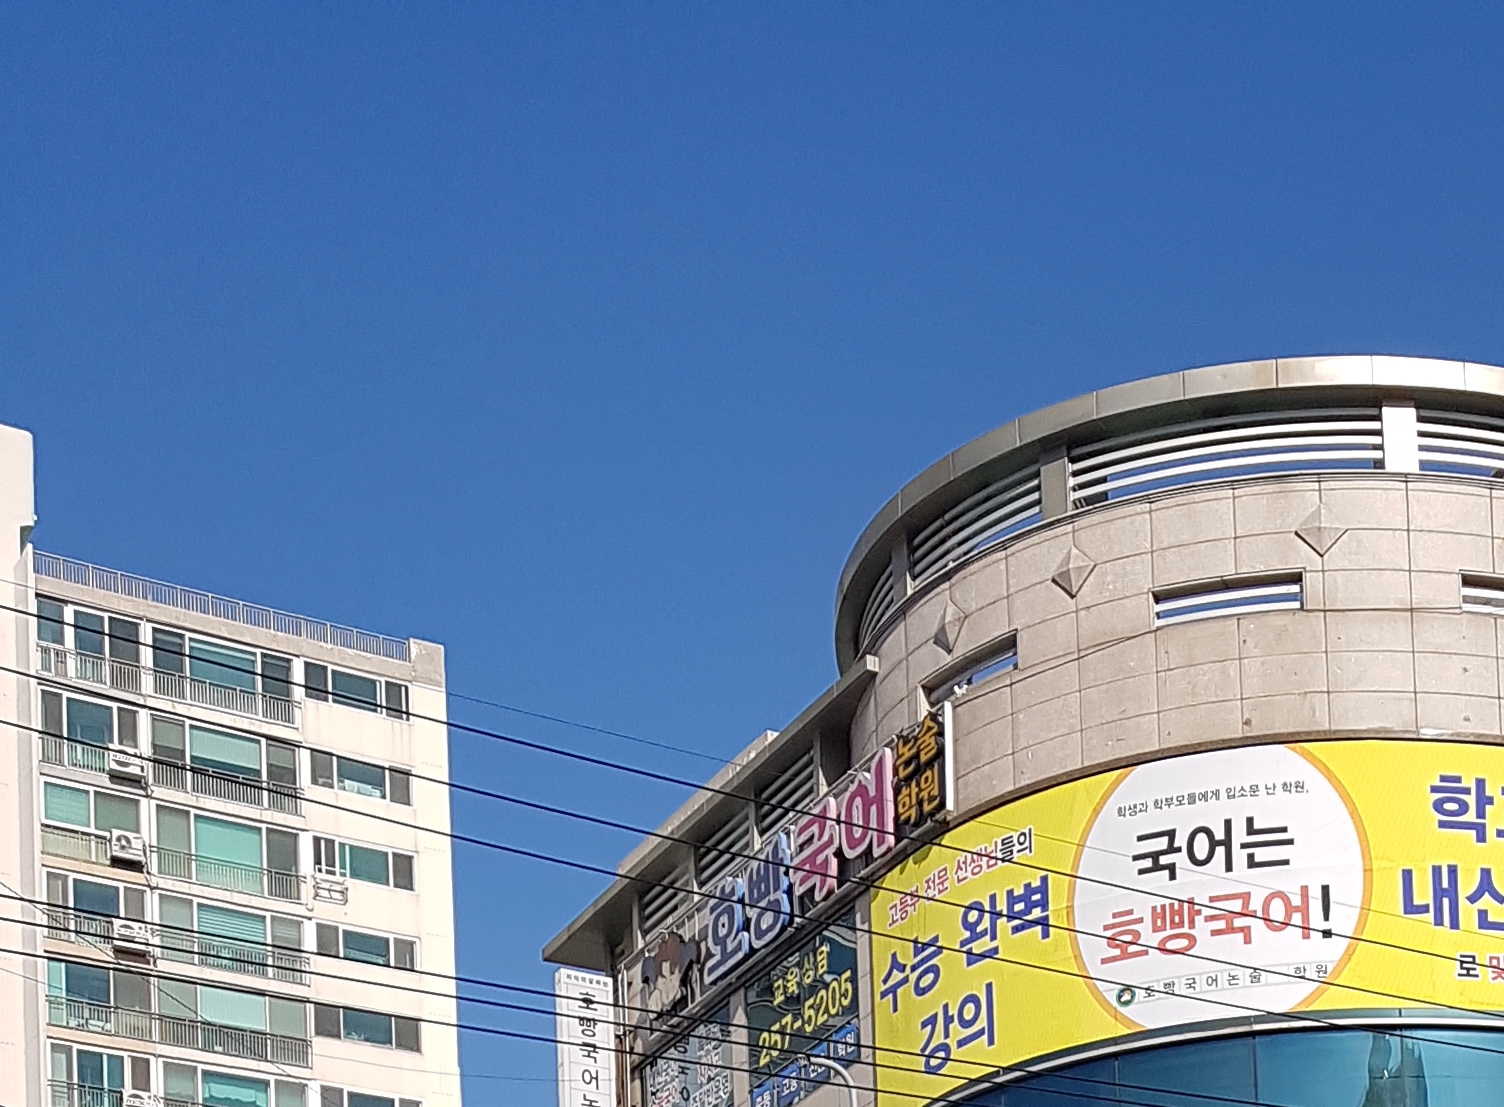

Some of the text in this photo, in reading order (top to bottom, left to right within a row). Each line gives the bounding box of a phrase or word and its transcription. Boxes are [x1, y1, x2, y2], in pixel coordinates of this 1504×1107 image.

[895, 716, 939, 780] 논술
[896, 768, 941, 824] 학원
[1117, 800, 1149, 818] 학생과
[1225, 784, 1260, 800] 입소문
[1264, 783, 1276, 796] 난
[702, 747, 894, 985] 호빵국어
[888, 826, 1033, 928] 고등부 전문 선생님들의
[1131, 815, 1295, 882] 국어는
[880, 873, 1051, 1014] 수능 완벽
[1100, 884, 1333, 966] 호빵국어!
[773, 944, 831, 1006] 교육상담
[1457, 953, 1480, 979] 로
[759, 969, 852, 1067] 257-5205
[919, 981, 996, 1075] 강의
